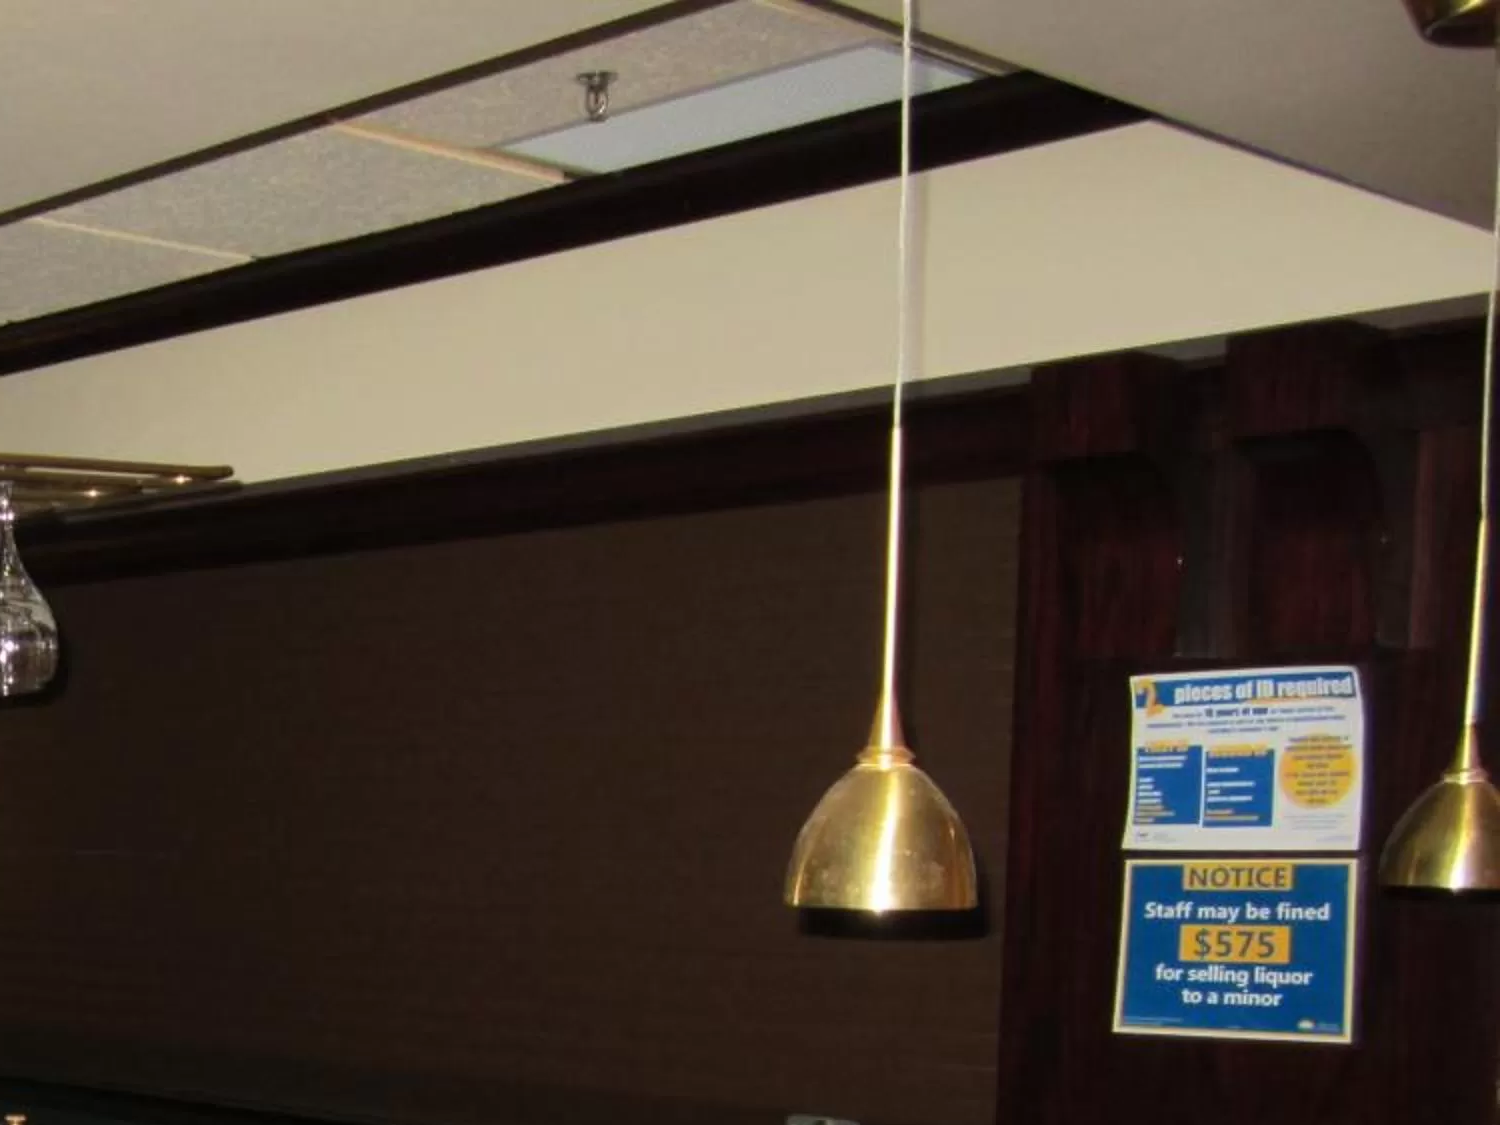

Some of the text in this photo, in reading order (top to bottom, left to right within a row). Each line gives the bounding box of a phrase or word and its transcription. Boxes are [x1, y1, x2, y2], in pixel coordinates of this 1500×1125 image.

[1174, 684, 1233, 705] pieces
[1278, 676, 1353, 698] required
[1187, 866, 1287, 889] NOTICE
[1144, 902, 1331, 923] Staff may be fined
[1193, 928, 1276, 959] $575
[1155, 963, 1313, 988] for selling liquor
[1181, 987, 1283, 1007] to a minor
